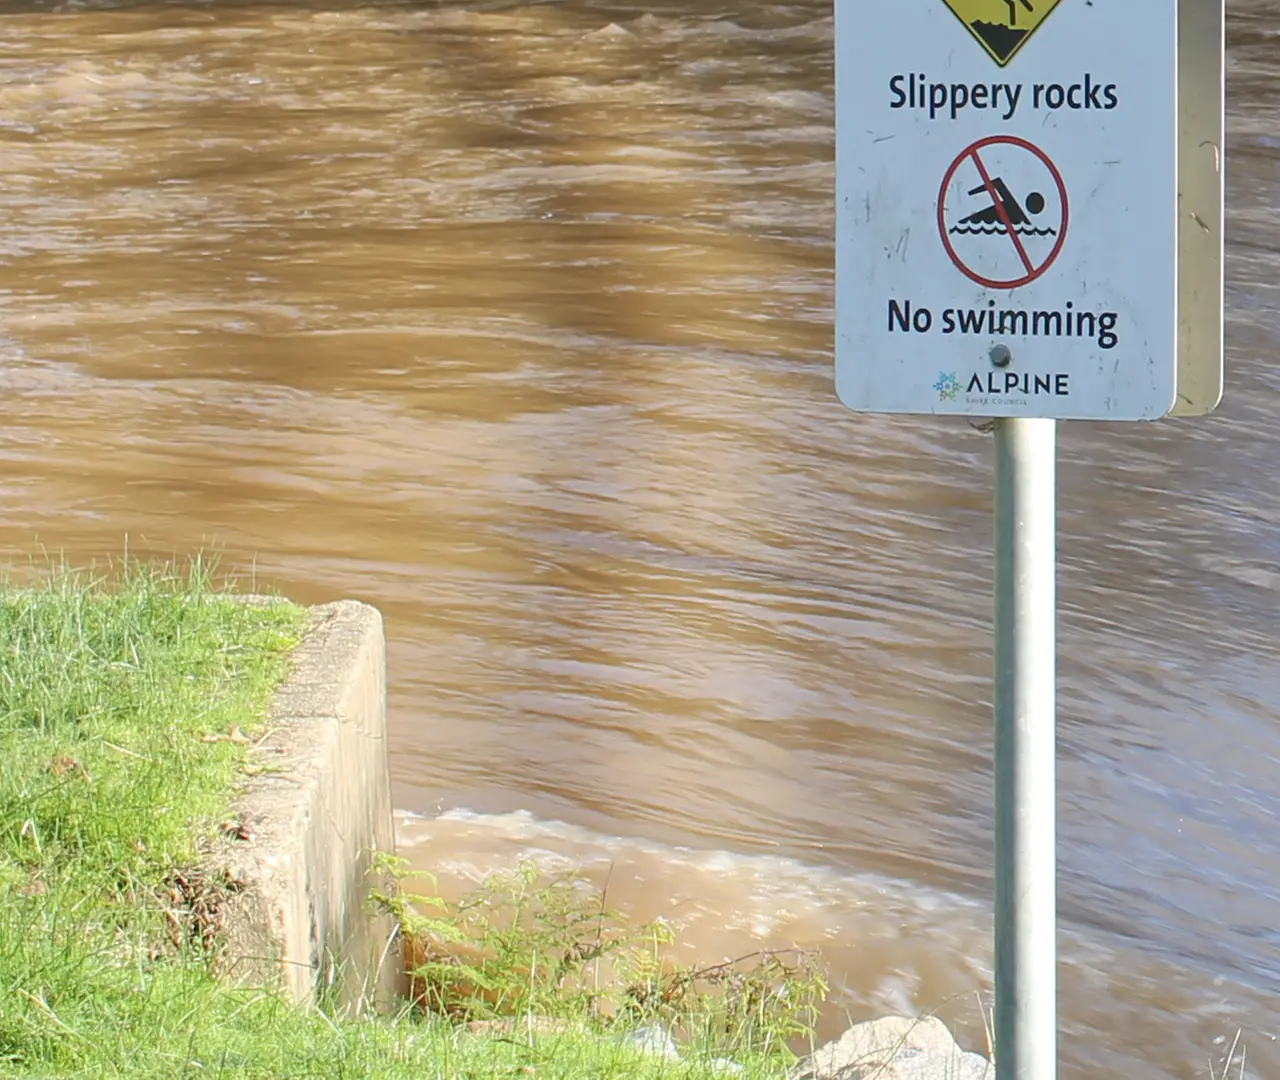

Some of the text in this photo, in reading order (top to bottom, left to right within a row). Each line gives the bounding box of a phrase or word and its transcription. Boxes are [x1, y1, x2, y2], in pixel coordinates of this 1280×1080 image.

[889, 72, 1119, 120] Slippery rocks
[887, 299, 1119, 349] No swimming
[965, 371, 1069, 396] ALPINE
